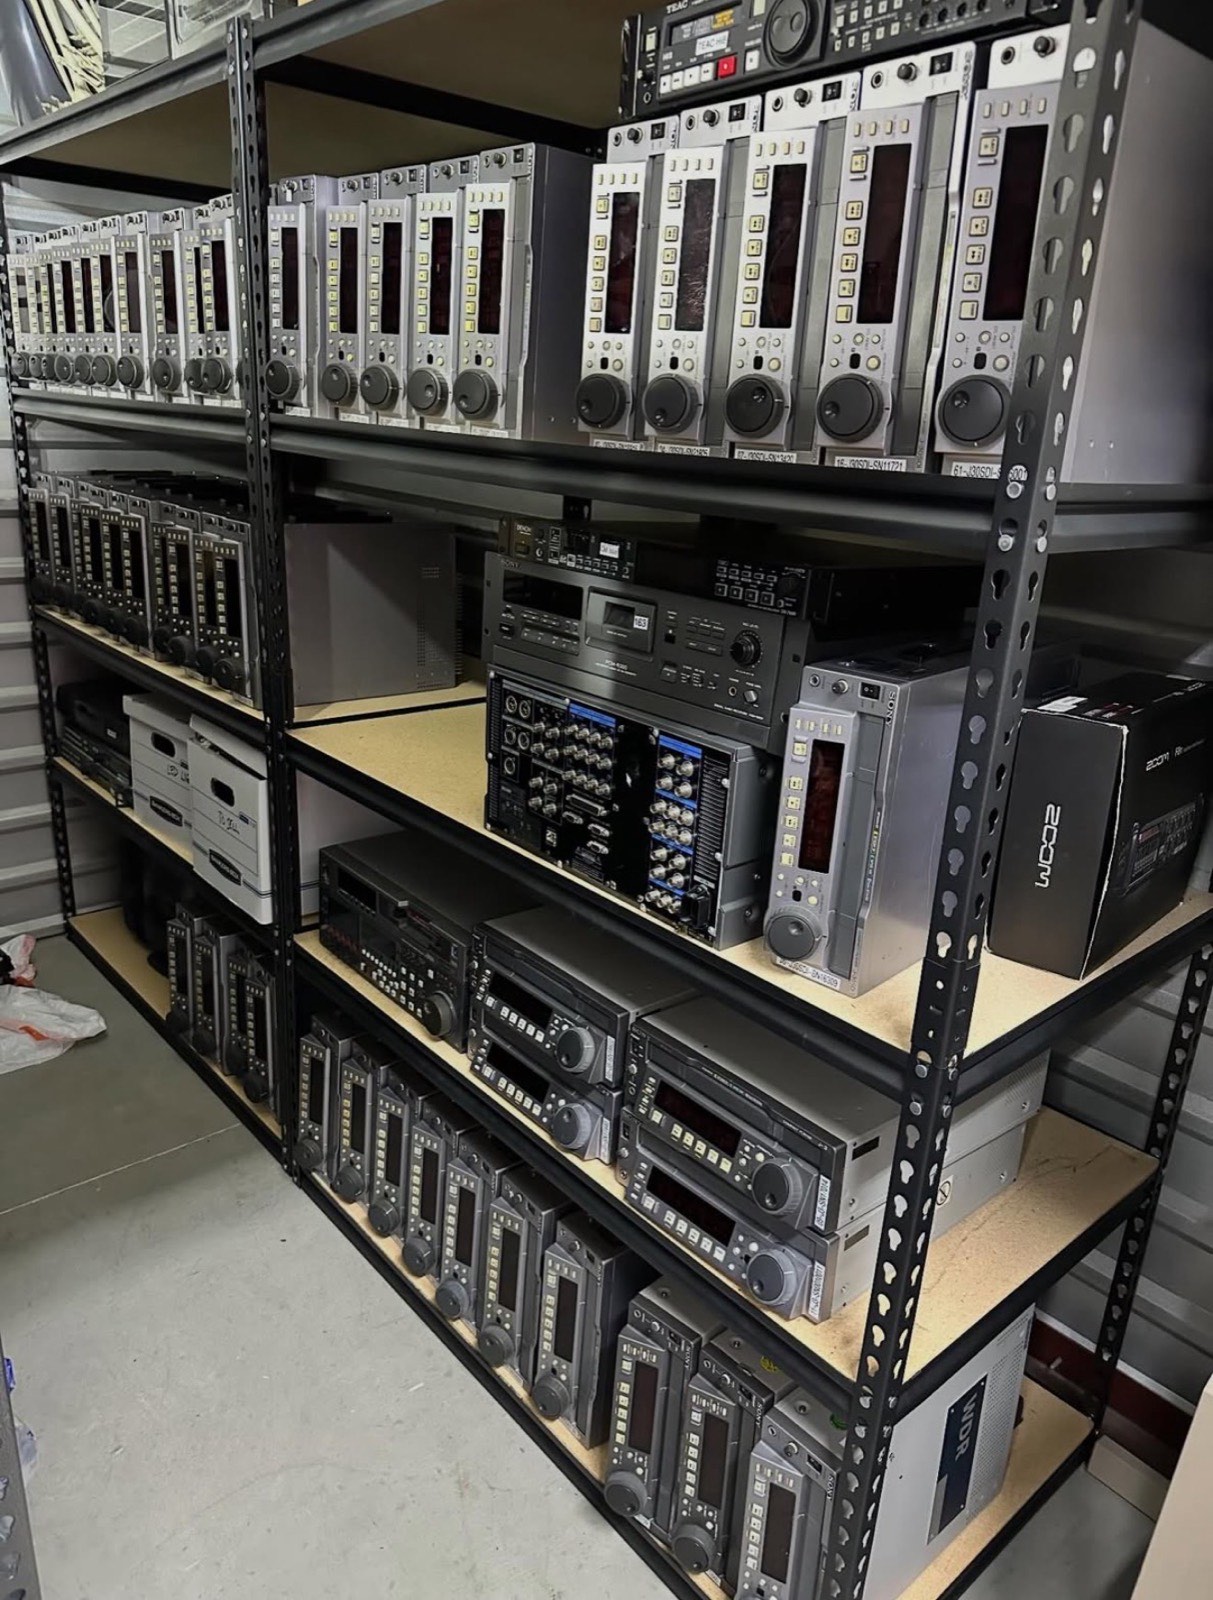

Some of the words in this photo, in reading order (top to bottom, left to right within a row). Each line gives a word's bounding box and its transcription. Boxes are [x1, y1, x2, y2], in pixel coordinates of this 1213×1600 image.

[666, 1, 689, 14] TEAC
[886, 691, 896, 728] SONY
[1146, 752, 1170, 771] ZOOM
[1034, 803, 1061, 888] ZOOM
[755, 1403, 764, 1429] SONY
[955, 1392, 978, 1461] WDR
[826, 1474, 835, 1501] SONY
